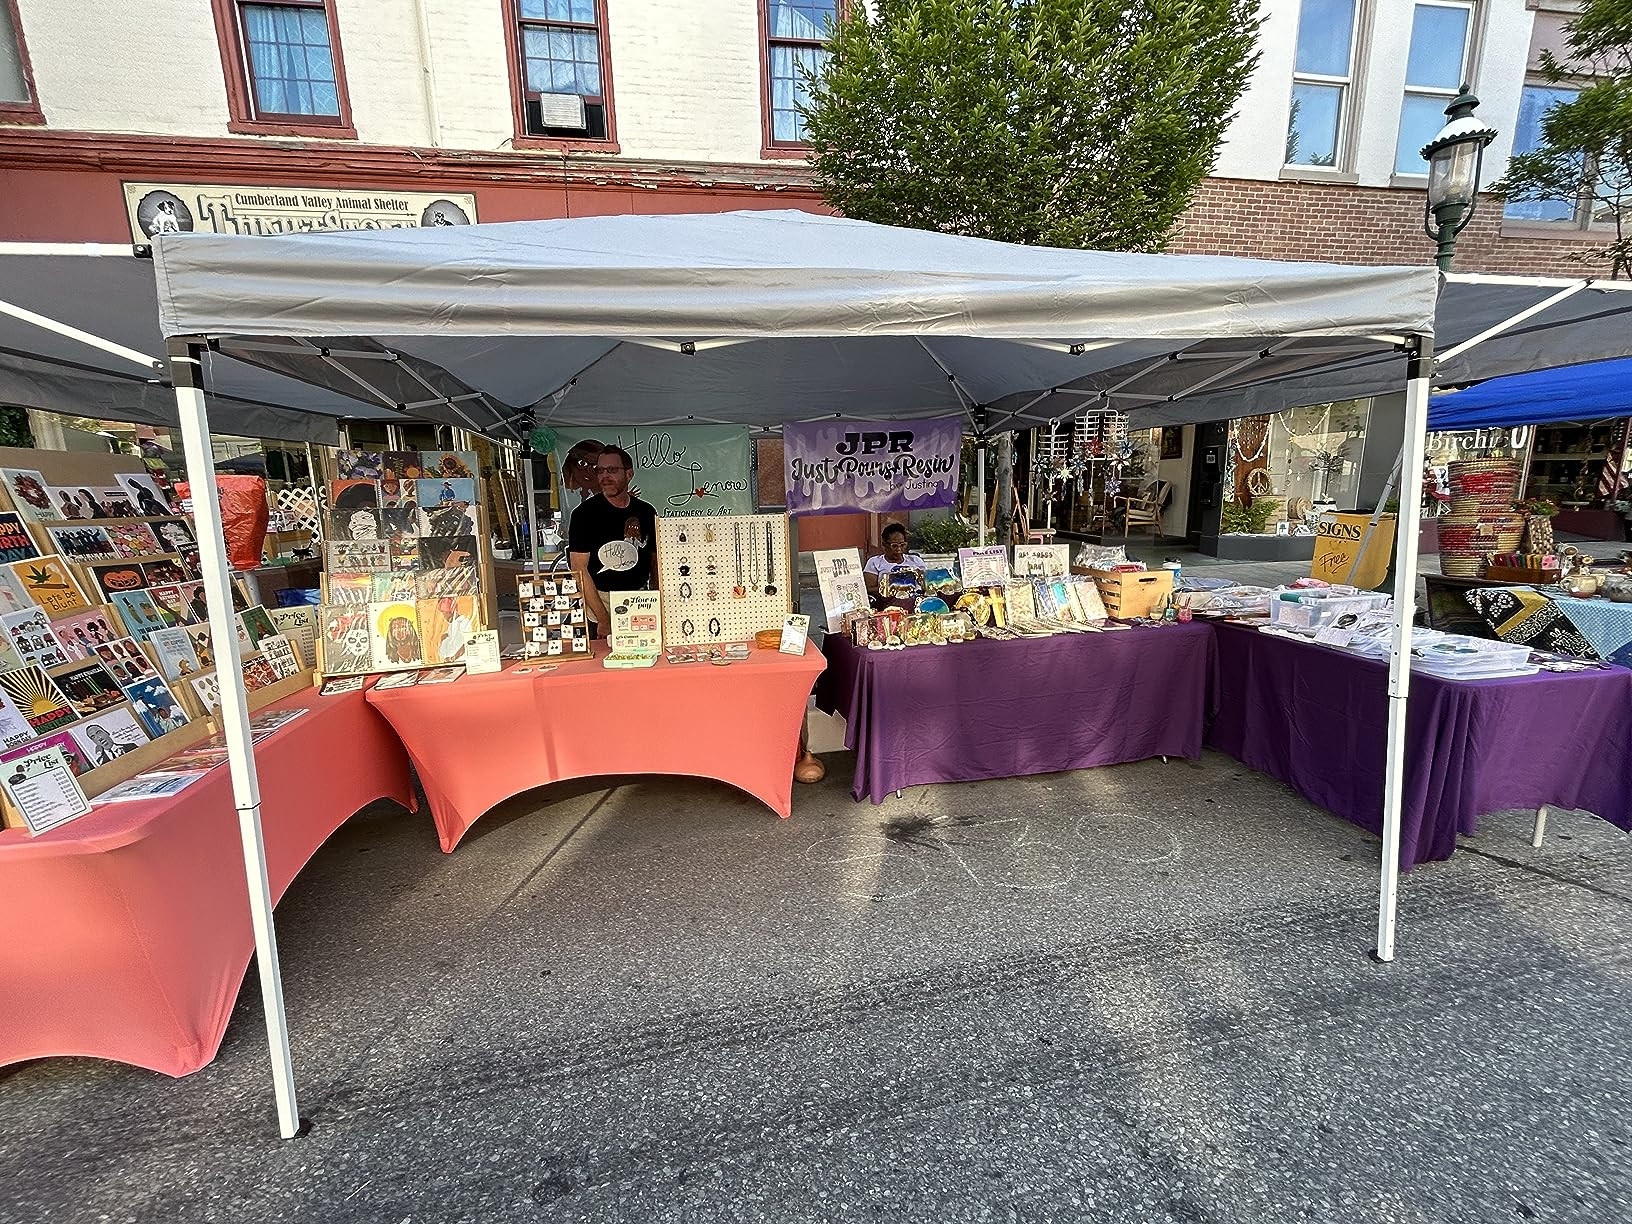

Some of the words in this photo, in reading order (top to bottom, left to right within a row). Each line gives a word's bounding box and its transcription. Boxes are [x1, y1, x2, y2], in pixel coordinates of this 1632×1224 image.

[235, 192, 300, 208] Cumberland
[301, 195, 333, 209] Valley
[335, 197, 372, 210] Animal
[374, 198, 409, 211] Shelter
[618, 427, 687, 469] Hello
[836, 431, 914, 455] JPR
[667, 461, 748, 507] Lenore
[1319, 521, 1361, 538] SIGNS
[1319, 552, 1349, 572] Free
[39, 593, 62, 605] Let's
[63, 589, 77, 599] be
[53, 599, 77, 611] blunt
[280, 612, 306, 624] Price
[29, 706, 73, 727] HAPPY
[3, 731, 29, 743] HAPPY
[23, 754, 51, 768] Price
